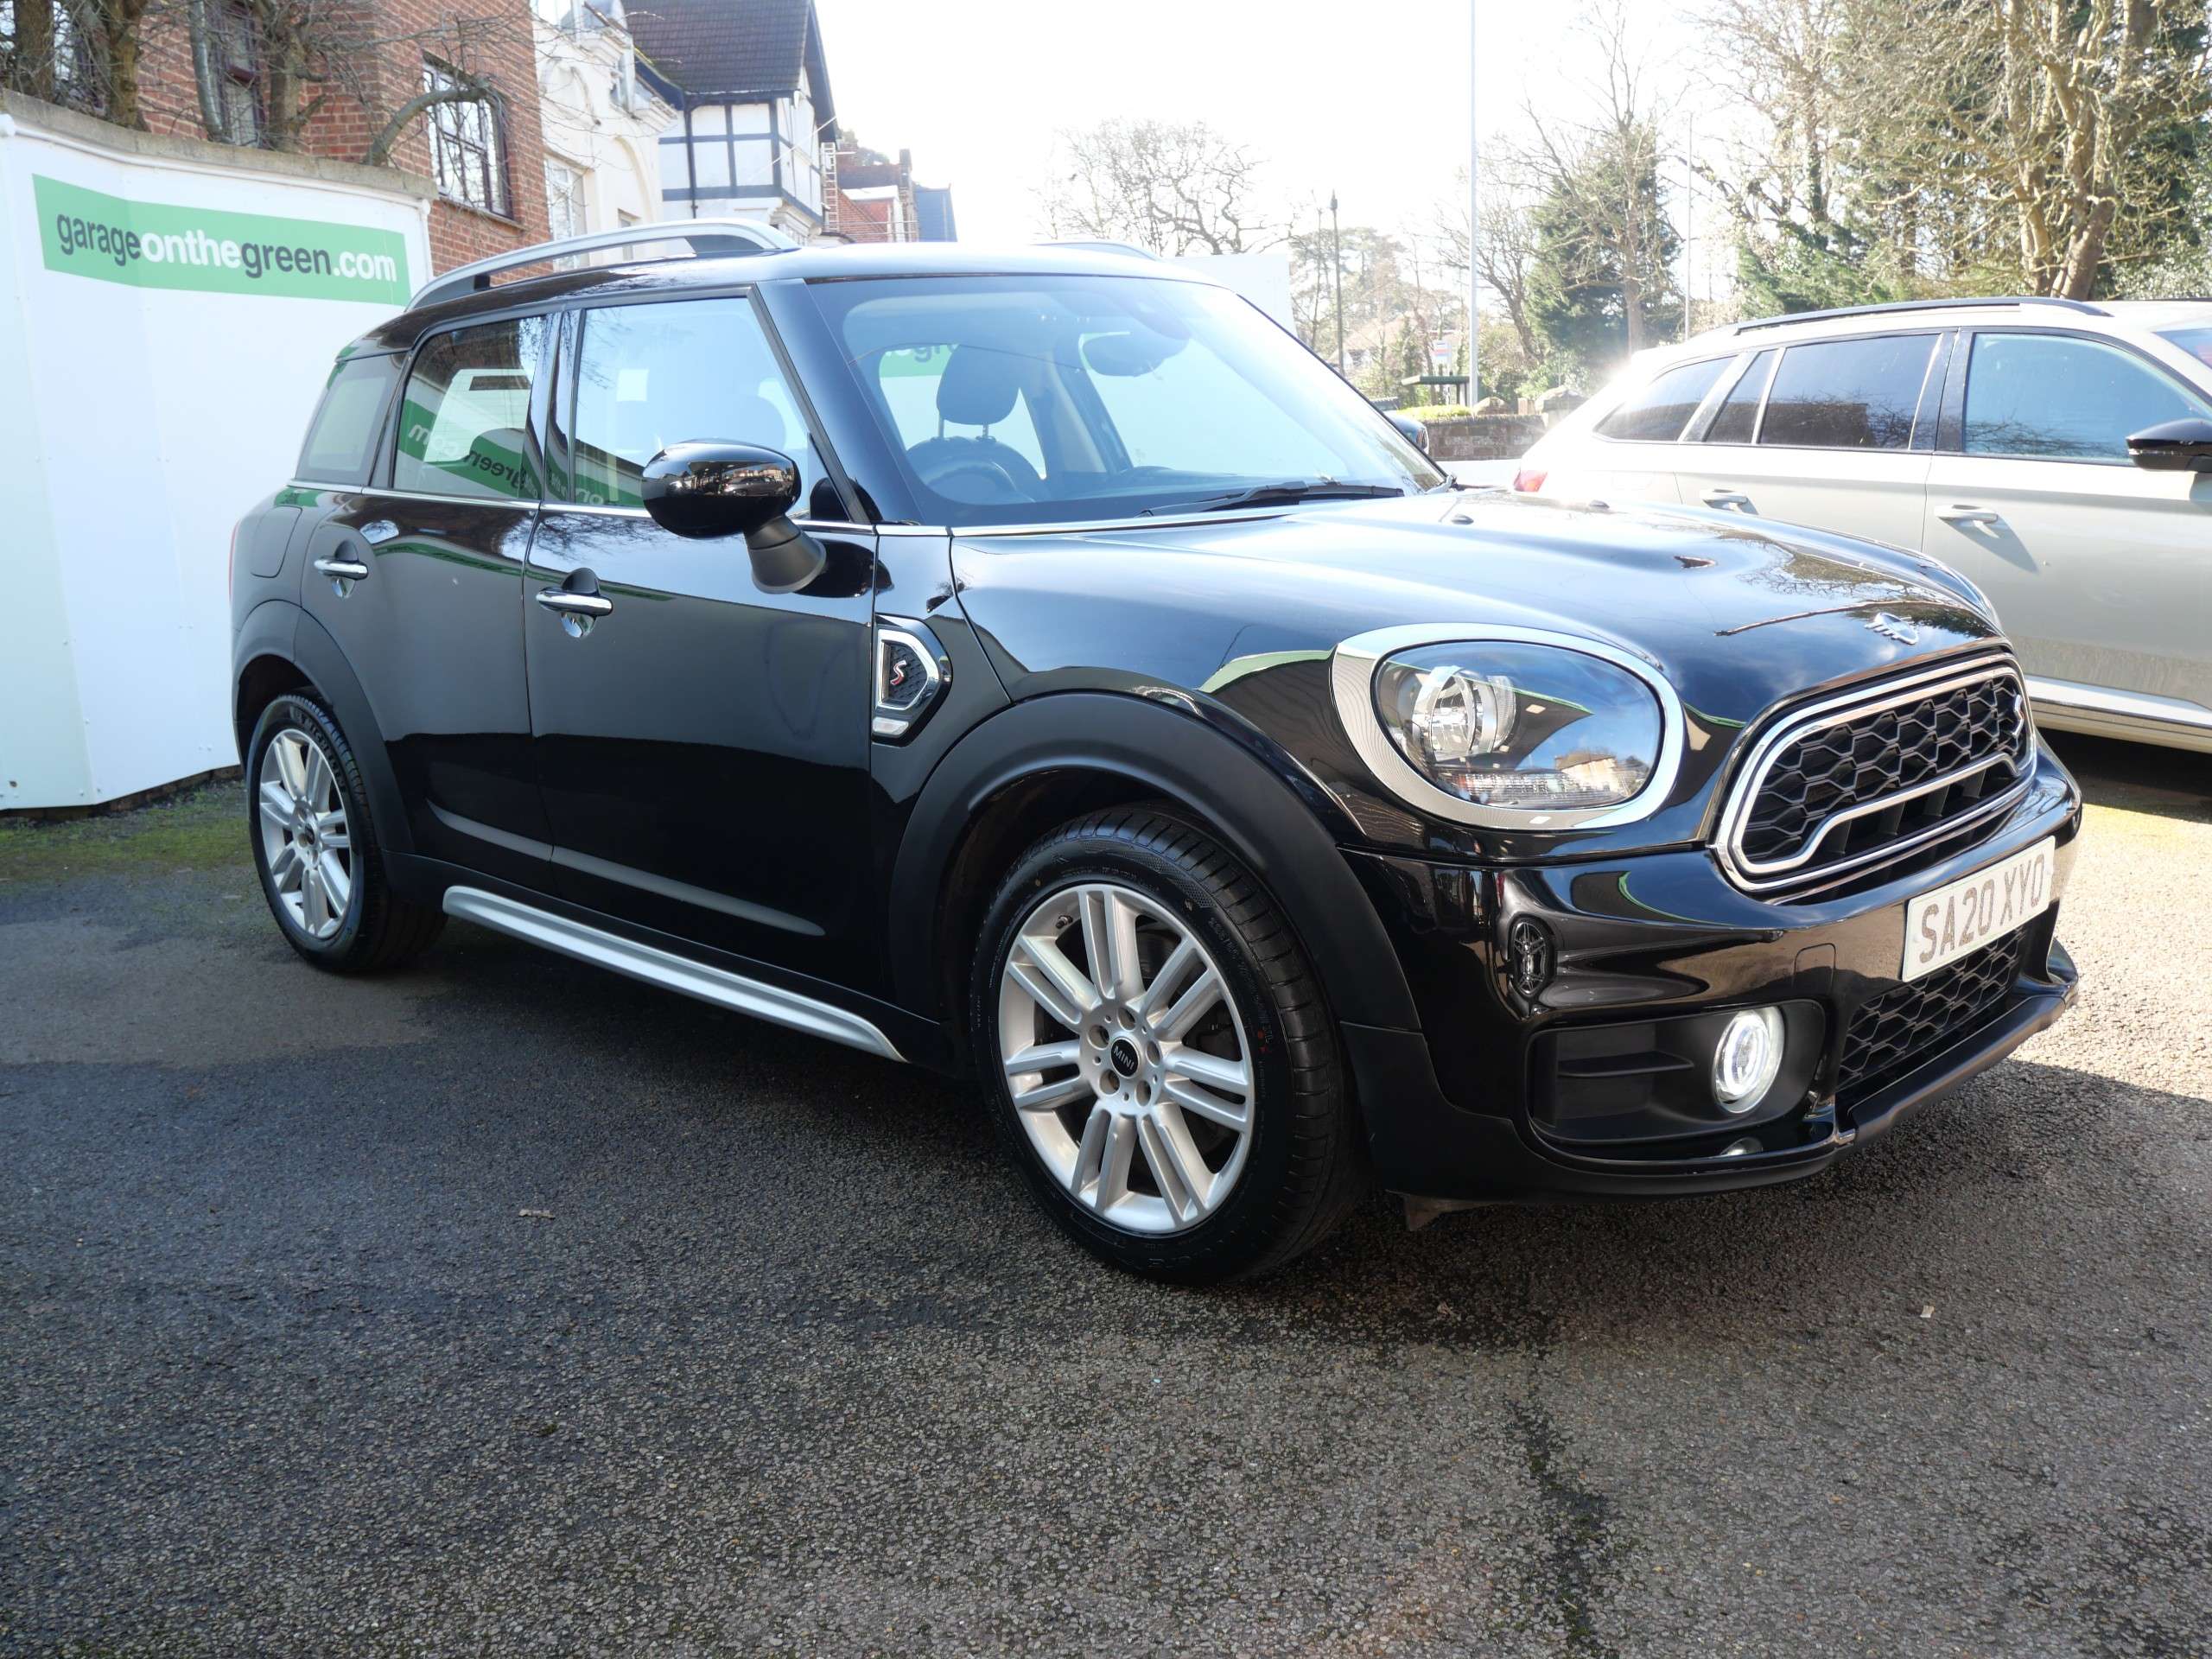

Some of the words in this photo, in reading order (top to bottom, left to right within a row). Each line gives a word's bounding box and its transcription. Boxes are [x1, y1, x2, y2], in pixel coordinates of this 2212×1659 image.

[56, 213, 397, 282] garageonthegreen.com
[890, 659, 907, 685] S
[1919, 880, 1995, 963] SA20
[1999, 854, 2045, 926] XYO
[1114, 1046, 1135, 1070] MINI
